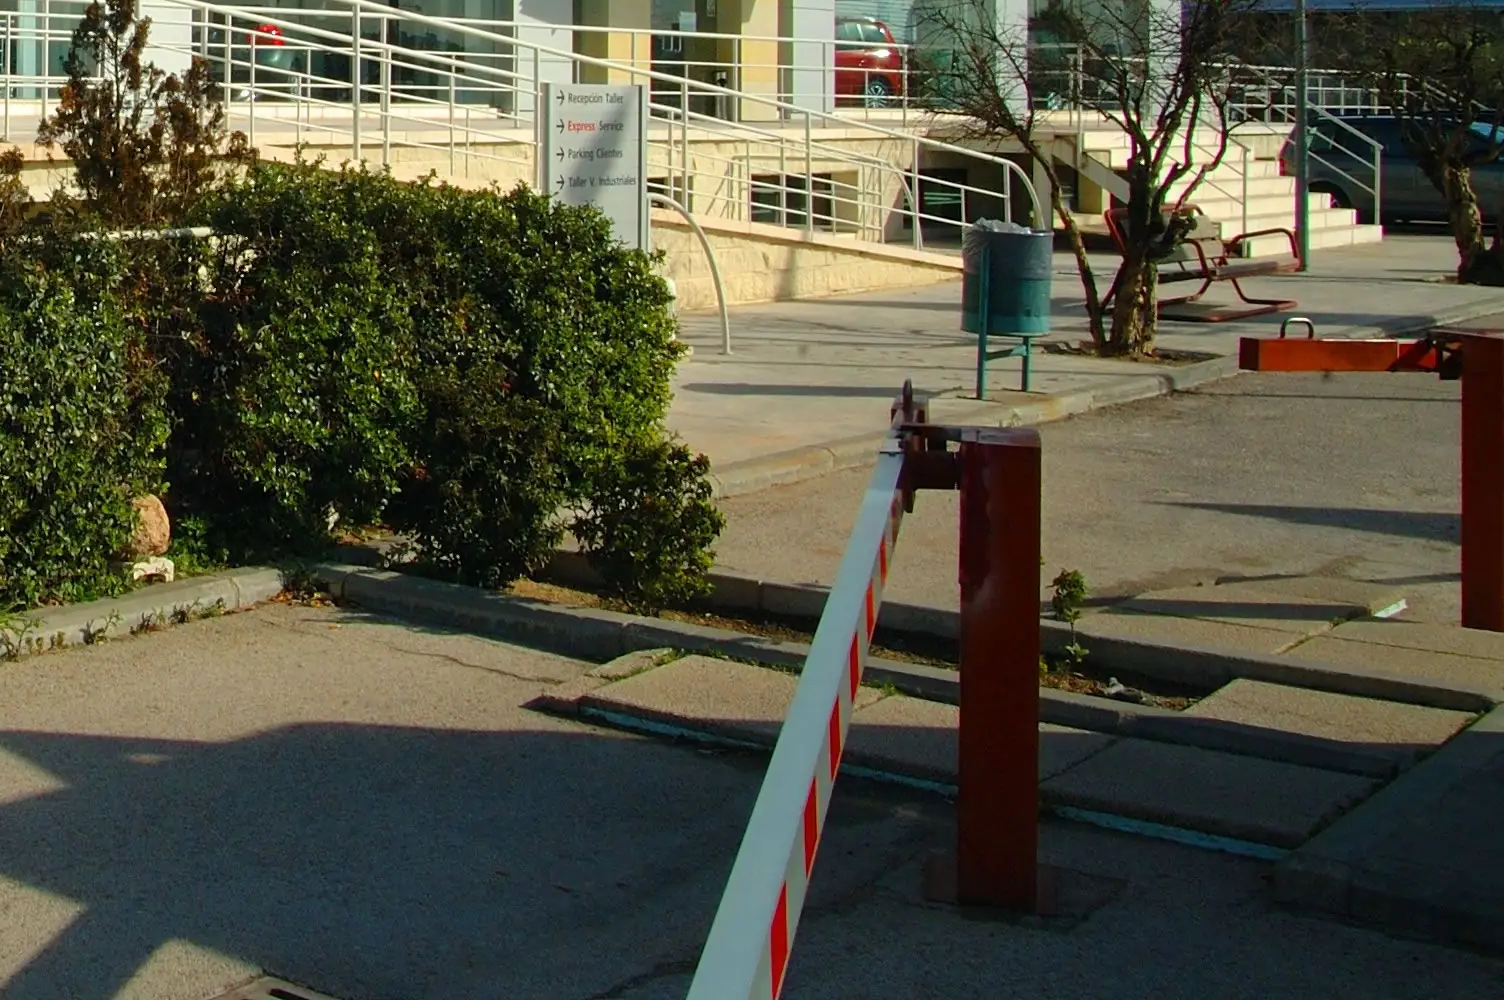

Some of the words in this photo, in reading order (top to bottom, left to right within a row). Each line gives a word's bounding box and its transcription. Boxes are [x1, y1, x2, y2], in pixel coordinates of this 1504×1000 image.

[606, 92, 624, 104] Taller
[568, 120, 596, 133] Express
[599, 120, 624, 131] Service
[568, 148, 594, 161] Parking
[596, 148, 623, 159] Clientes
[568, 176, 587, 187] Taller
[598, 175, 636, 187] Industriales
